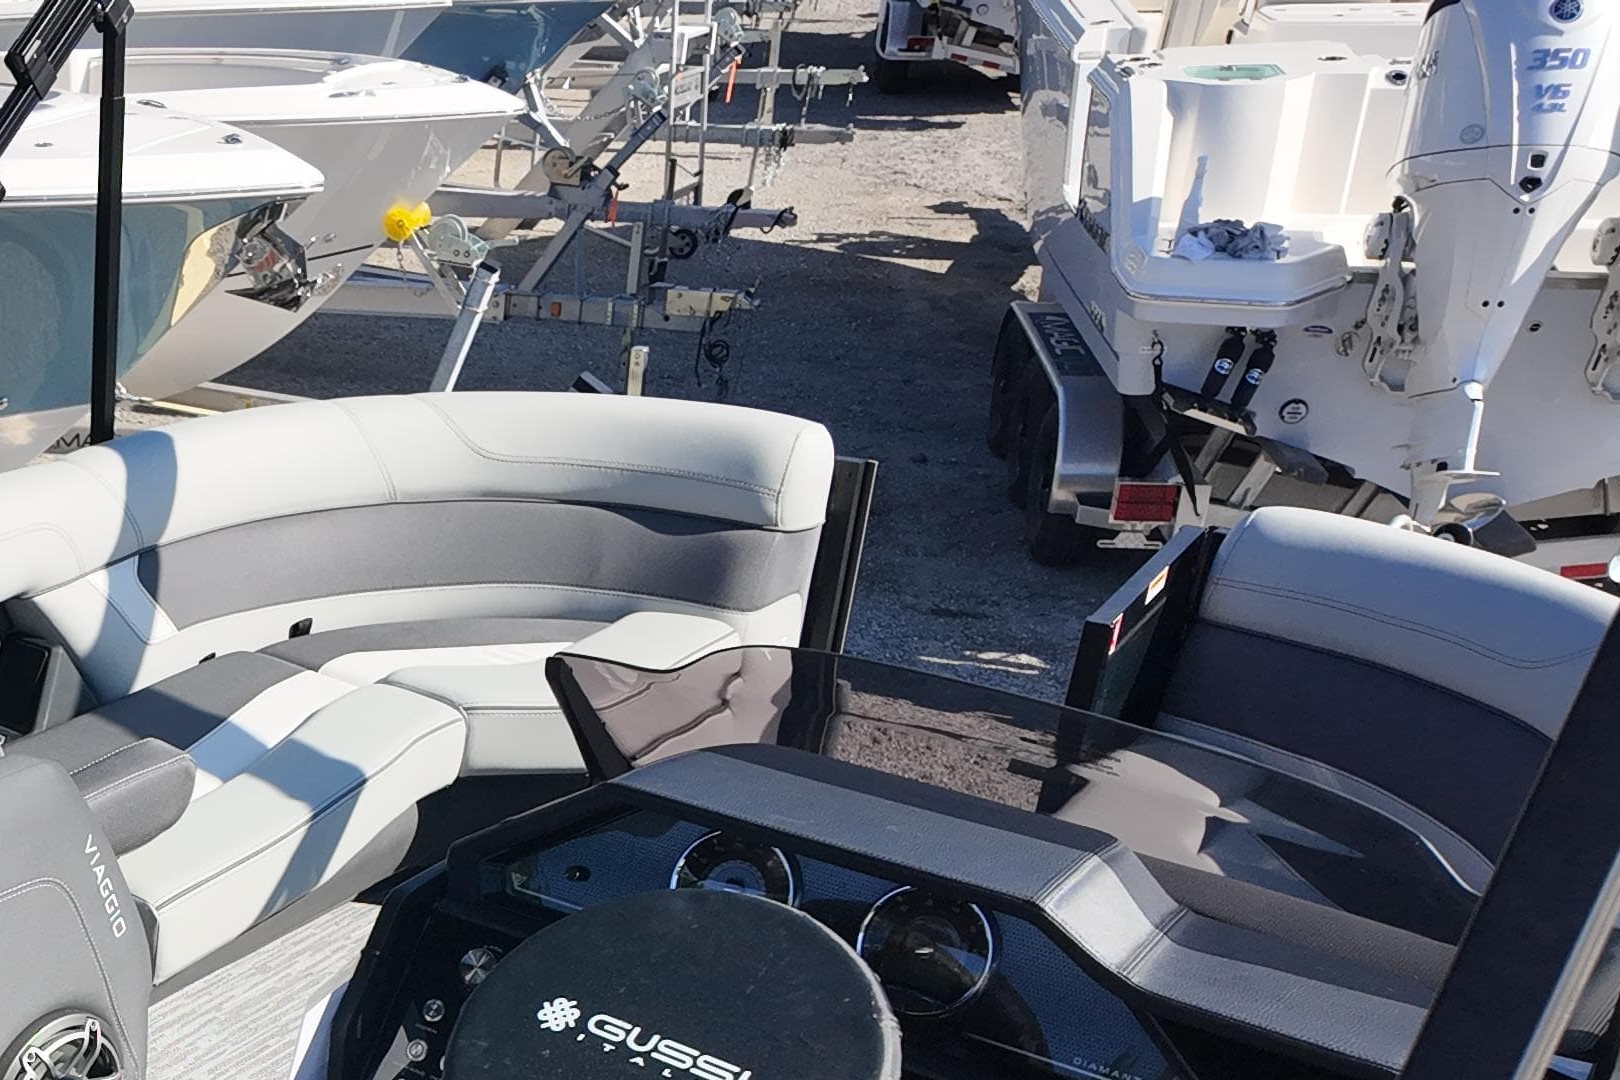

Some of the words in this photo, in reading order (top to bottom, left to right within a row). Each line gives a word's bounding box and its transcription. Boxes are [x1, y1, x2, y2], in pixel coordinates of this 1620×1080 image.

[1526, 47, 1591, 70] 350
[1534, 83, 1572, 100] V6
[84, 833, 127, 938] VIAGGIO
